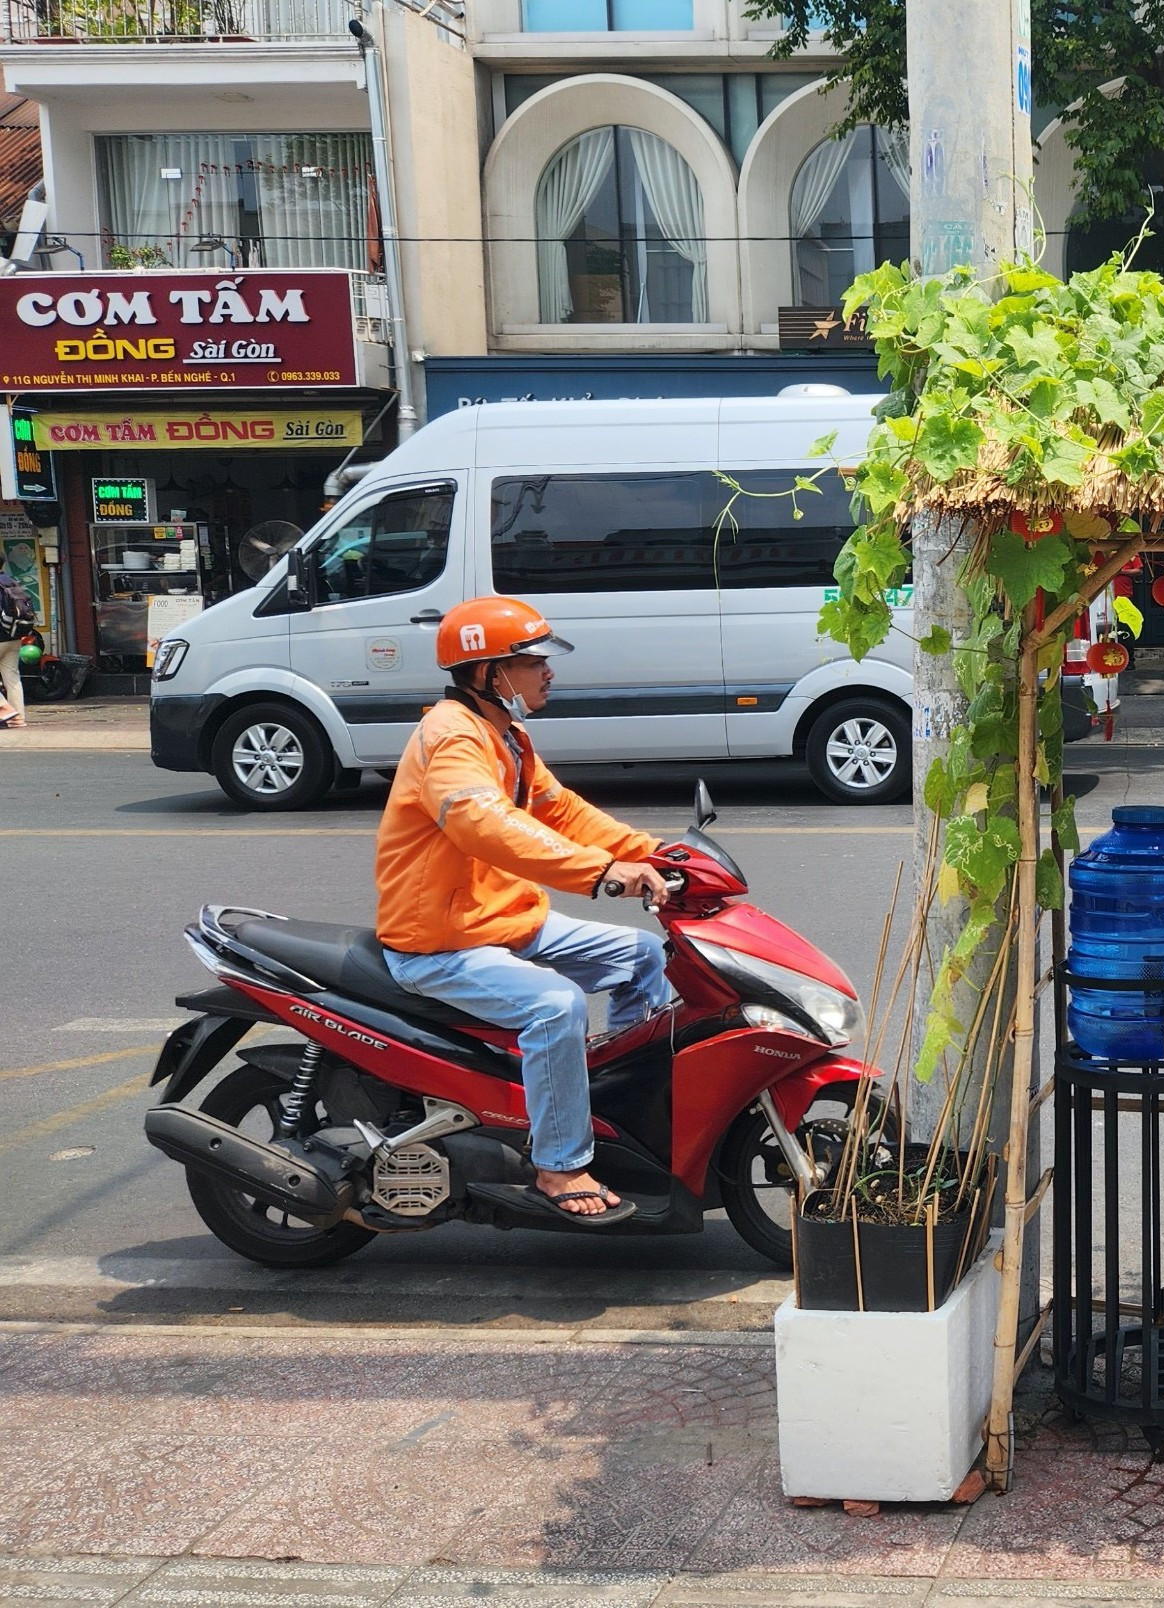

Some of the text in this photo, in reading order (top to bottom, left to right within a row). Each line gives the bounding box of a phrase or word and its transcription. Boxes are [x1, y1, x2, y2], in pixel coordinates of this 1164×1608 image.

[16, 276, 310, 326] CƠM TẤM
[55, 329, 276, 361] ĐỒNG Sài Gòn
[33, 371, 74, 384] NGUYỄN
[76, 374, 92, 386] THỊ
[94, 373, 118, 384] MINH
[121, 373, 144, 383] KHAI
[151, 373, 159, 382] P.
[161, 370, 181, 383] BẾN
[220, 372, 236, 383] Q.1
[281, 371, 340, 381] 0963.339.033
[50, 413, 345, 443] CƠM TẤM ĐỒNG Sài Gòn
[324, 1018, 388, 1051] BLADE
[753, 1044, 802, 1060] HONDA
